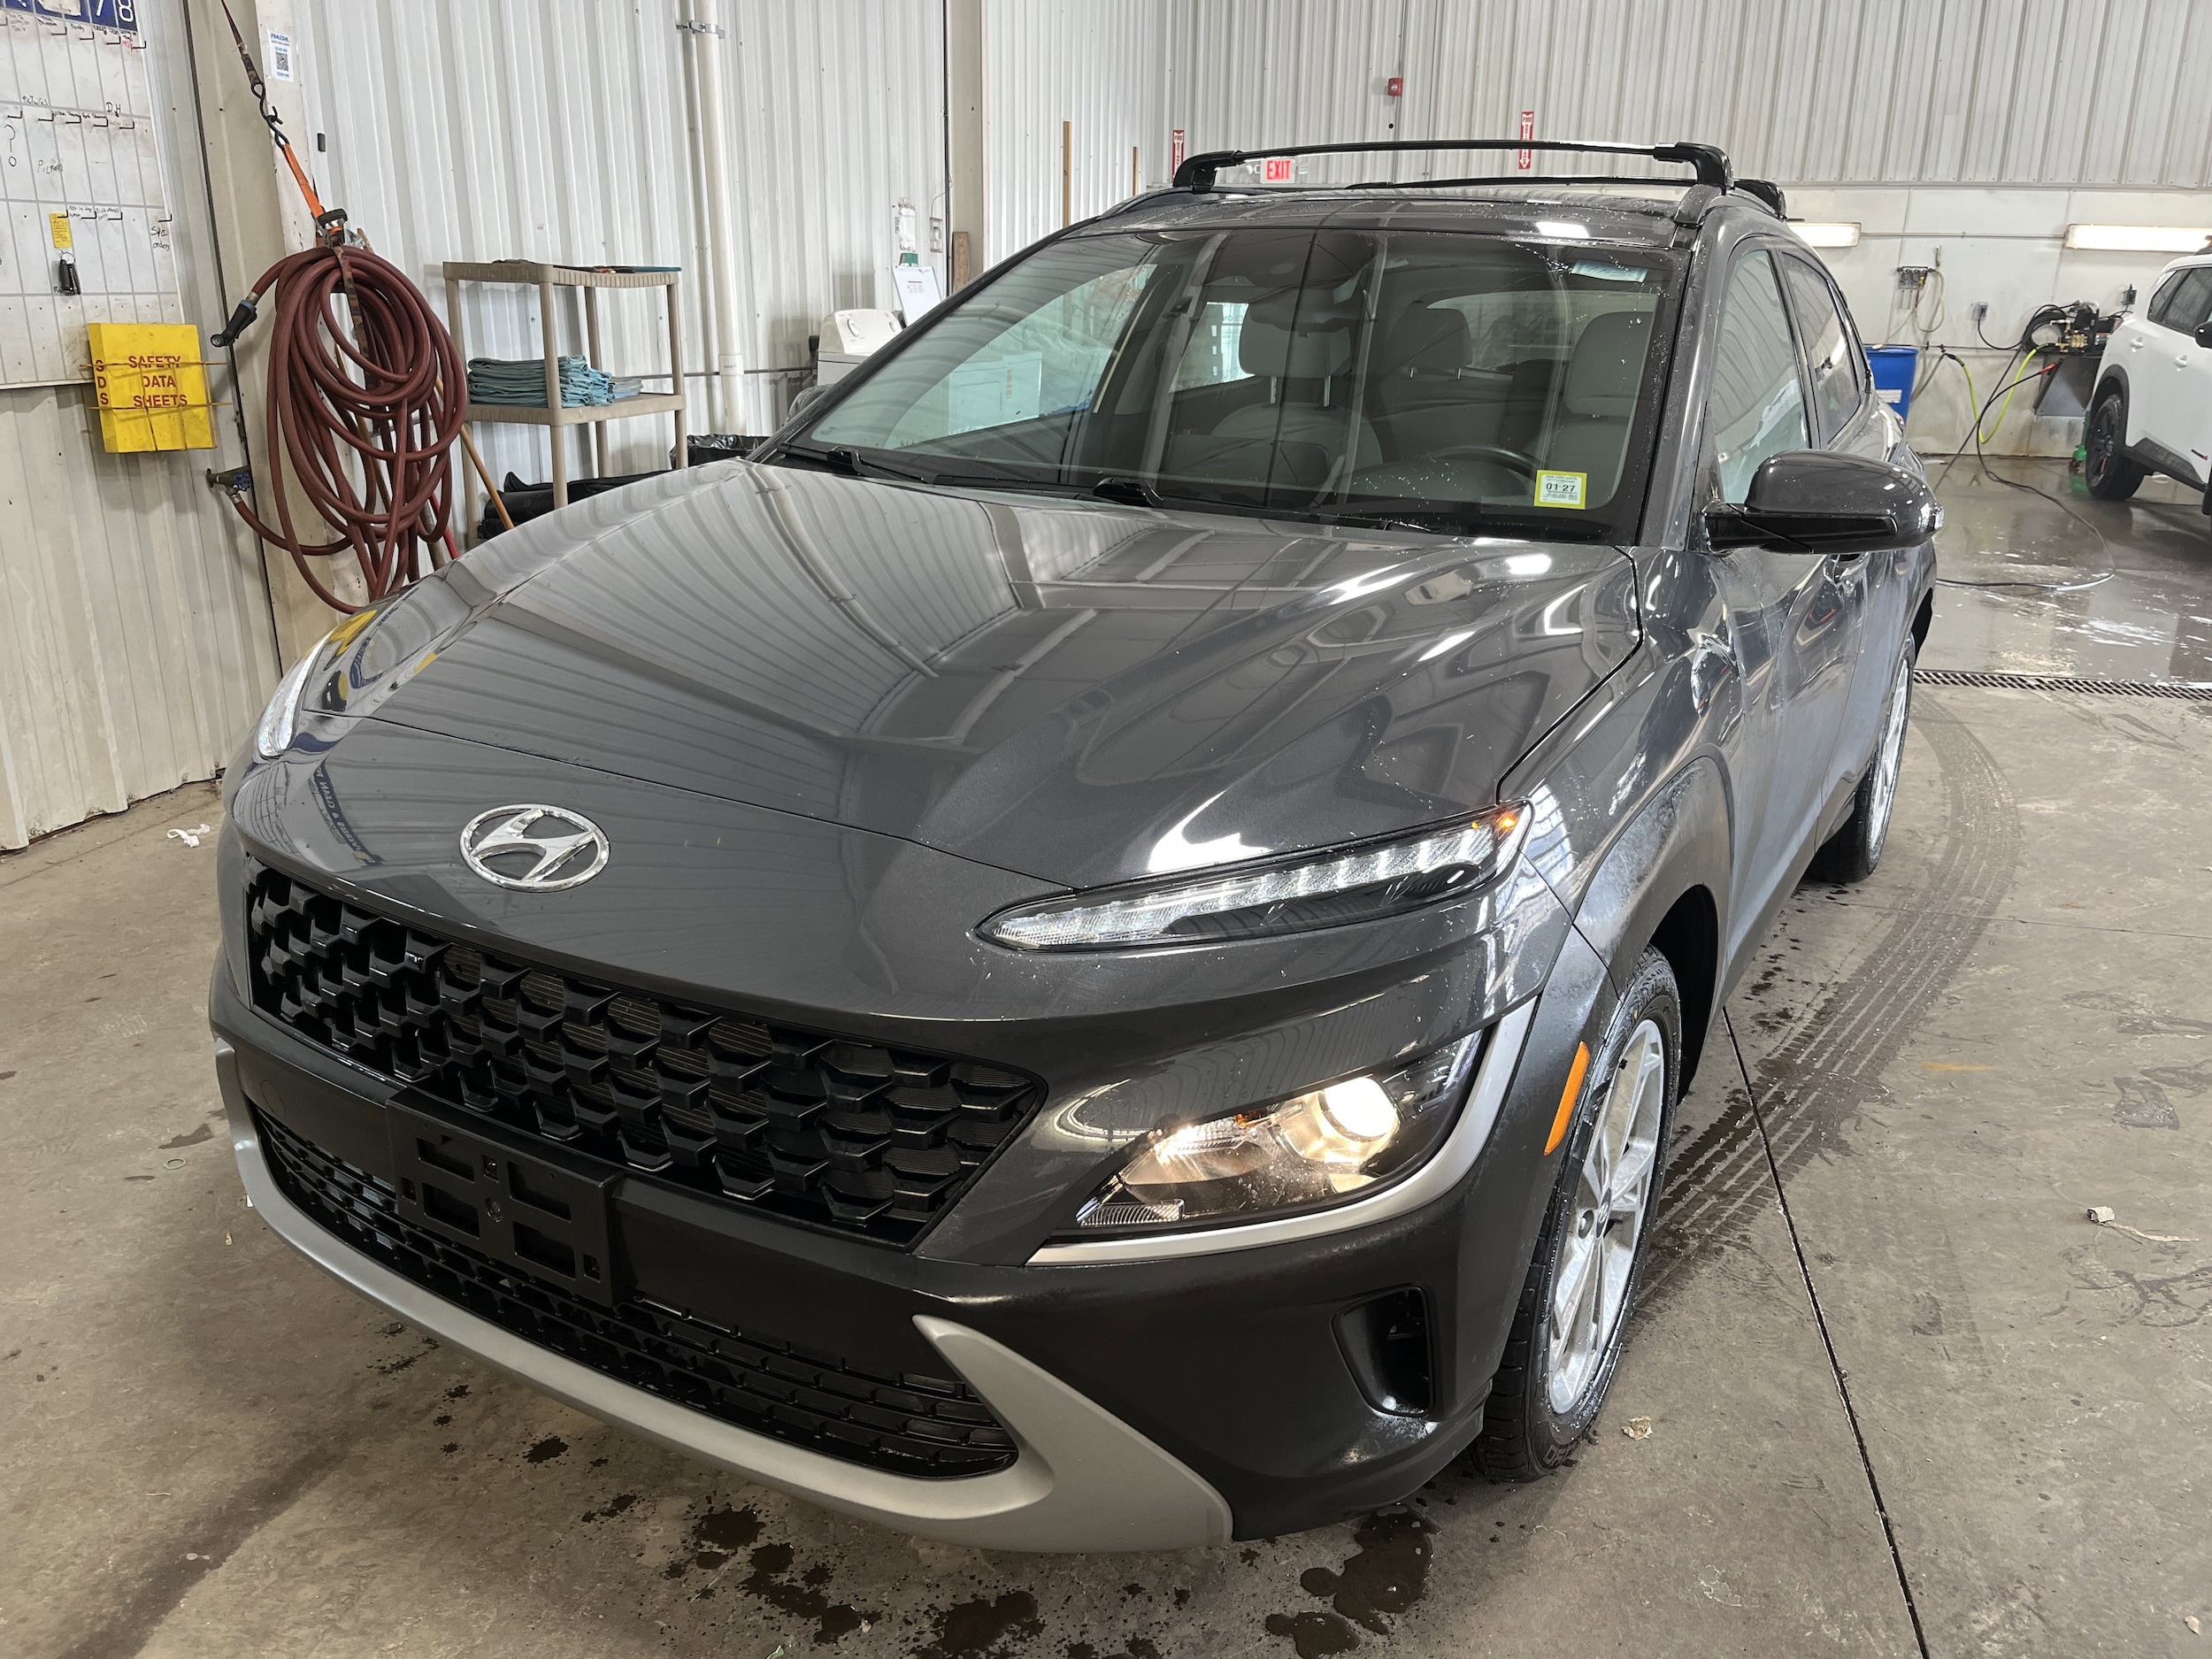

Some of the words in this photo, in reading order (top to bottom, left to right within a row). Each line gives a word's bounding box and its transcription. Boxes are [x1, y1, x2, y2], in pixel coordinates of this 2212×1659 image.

[1266, 160, 1291, 180] EXIT
[128, 356, 181, 368] SAFETY
[142, 375, 177, 388] DATA
[134, 395, 188, 408] SHEETS
